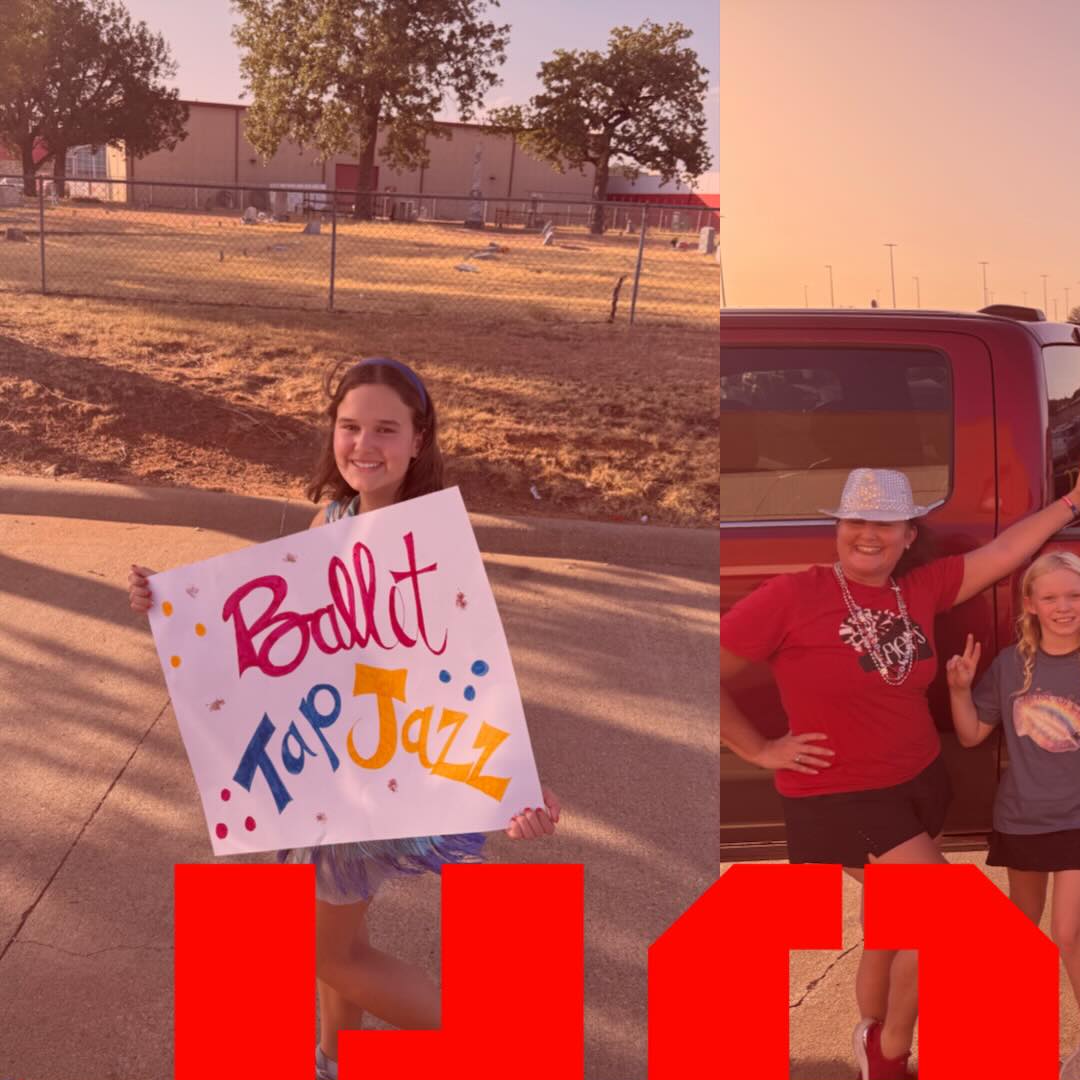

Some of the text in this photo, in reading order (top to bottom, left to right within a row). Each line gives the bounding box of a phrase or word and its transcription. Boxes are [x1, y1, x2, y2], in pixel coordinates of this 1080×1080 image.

[222, 531, 448, 679] Ballet
[232, 663, 512, 815] Tap Jazz
